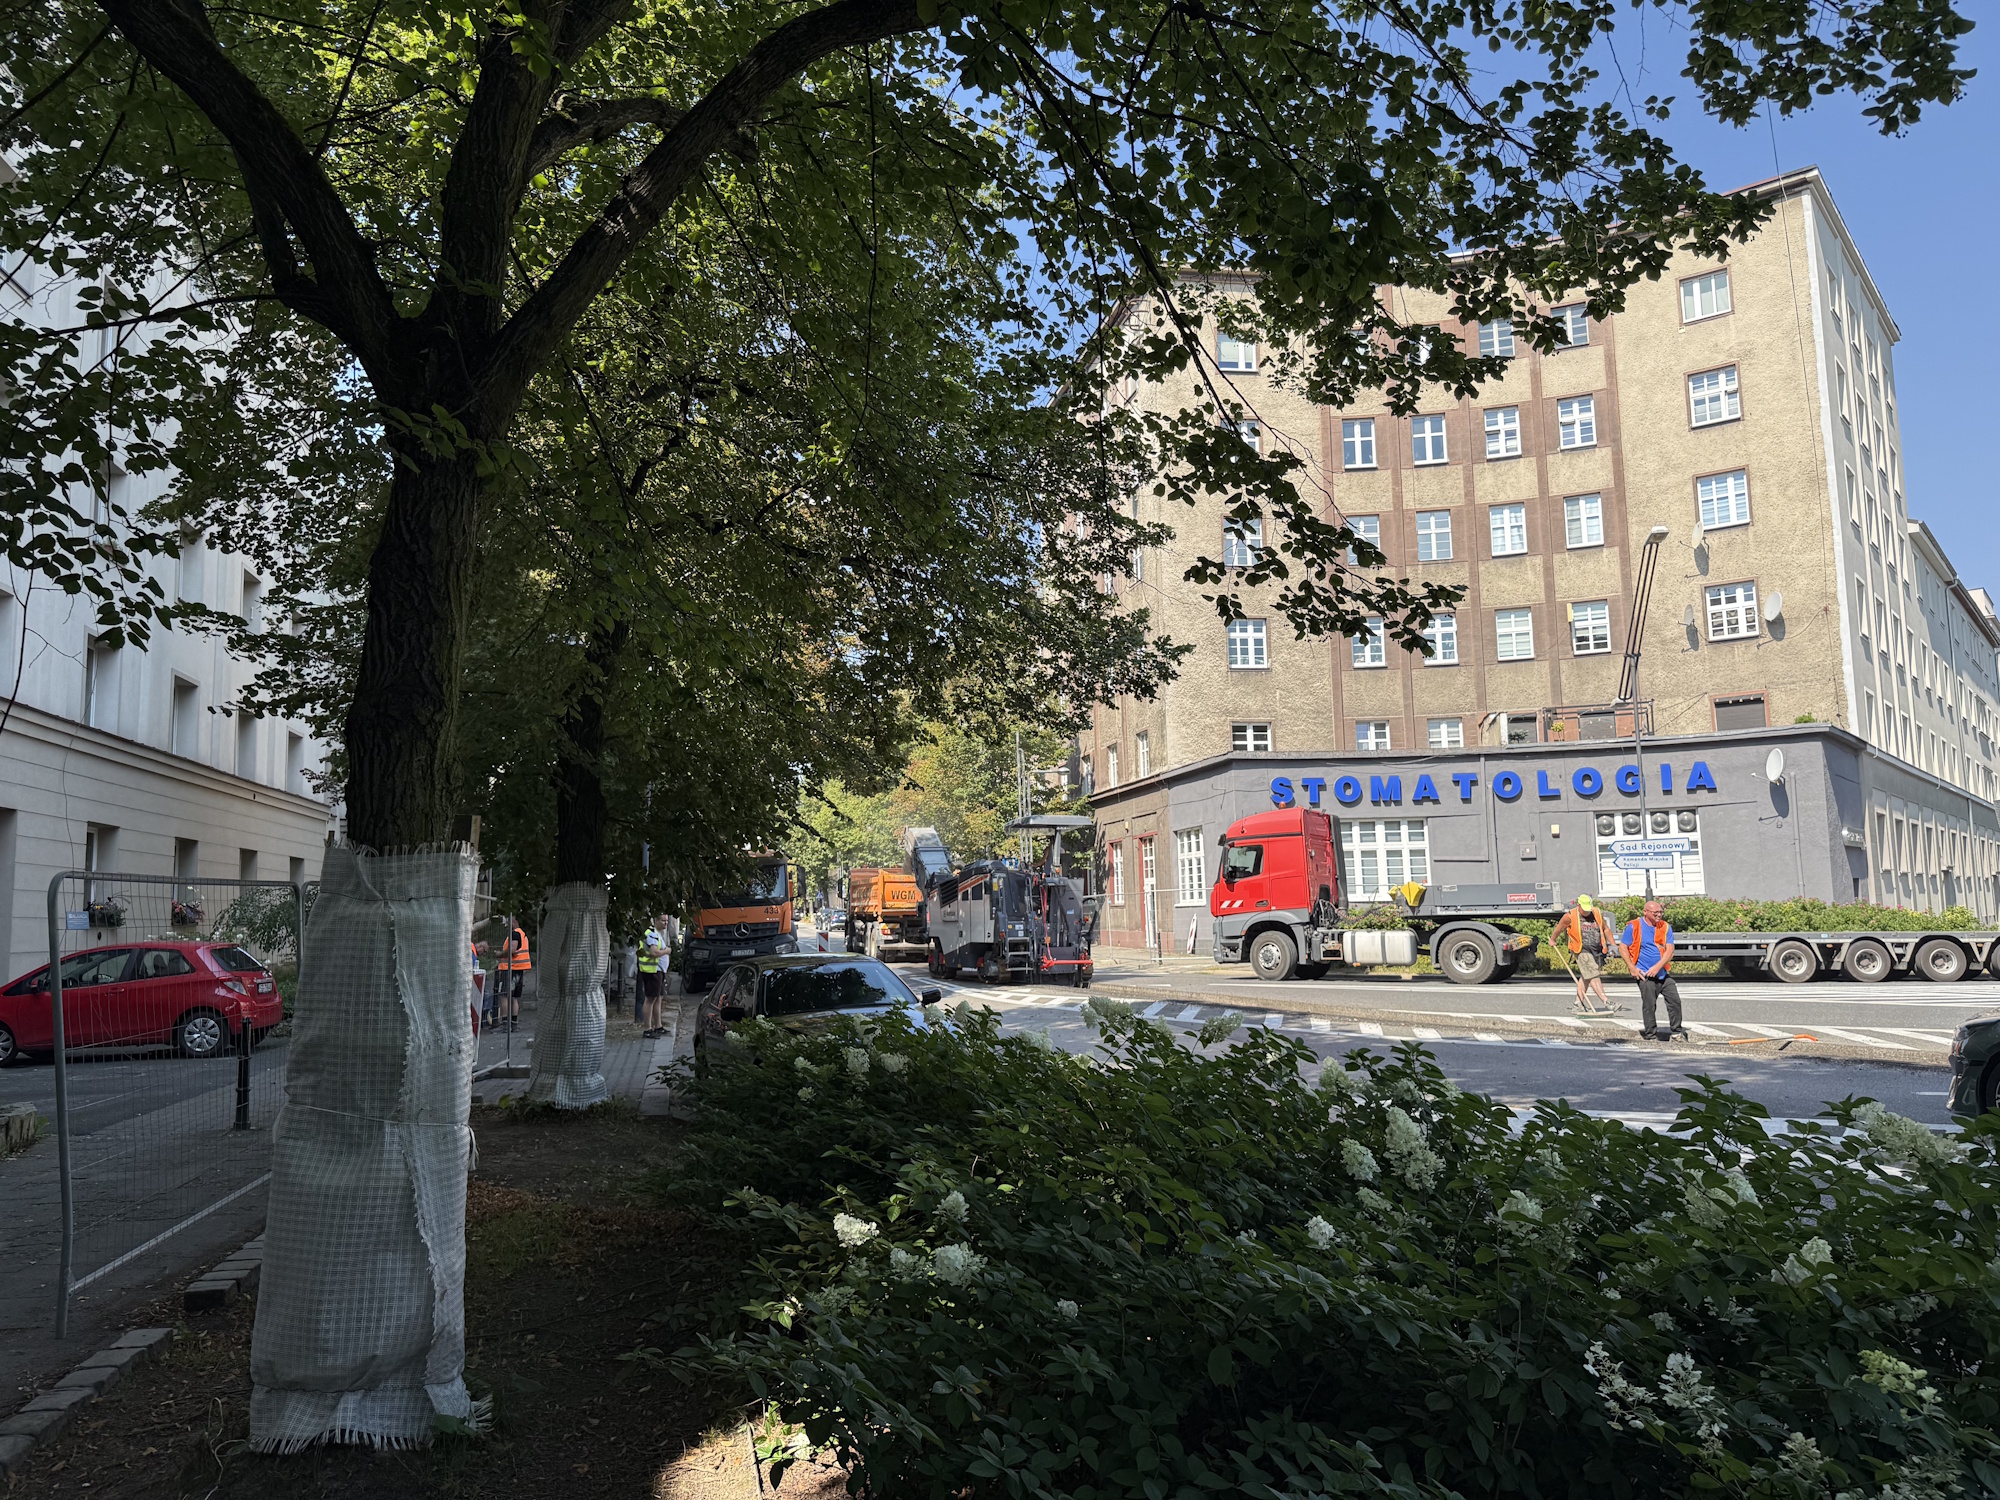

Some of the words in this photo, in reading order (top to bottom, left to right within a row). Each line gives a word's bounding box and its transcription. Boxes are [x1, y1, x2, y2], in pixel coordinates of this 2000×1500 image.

[1271, 761, 1717, 804] STOMATOLOGIA
[1620, 844, 1637, 852] Sąd
[1641, 842, 1685, 851] Rejonowy
[891, 890, 916, 900] WGM
[764, 906, 779, 914] 433
